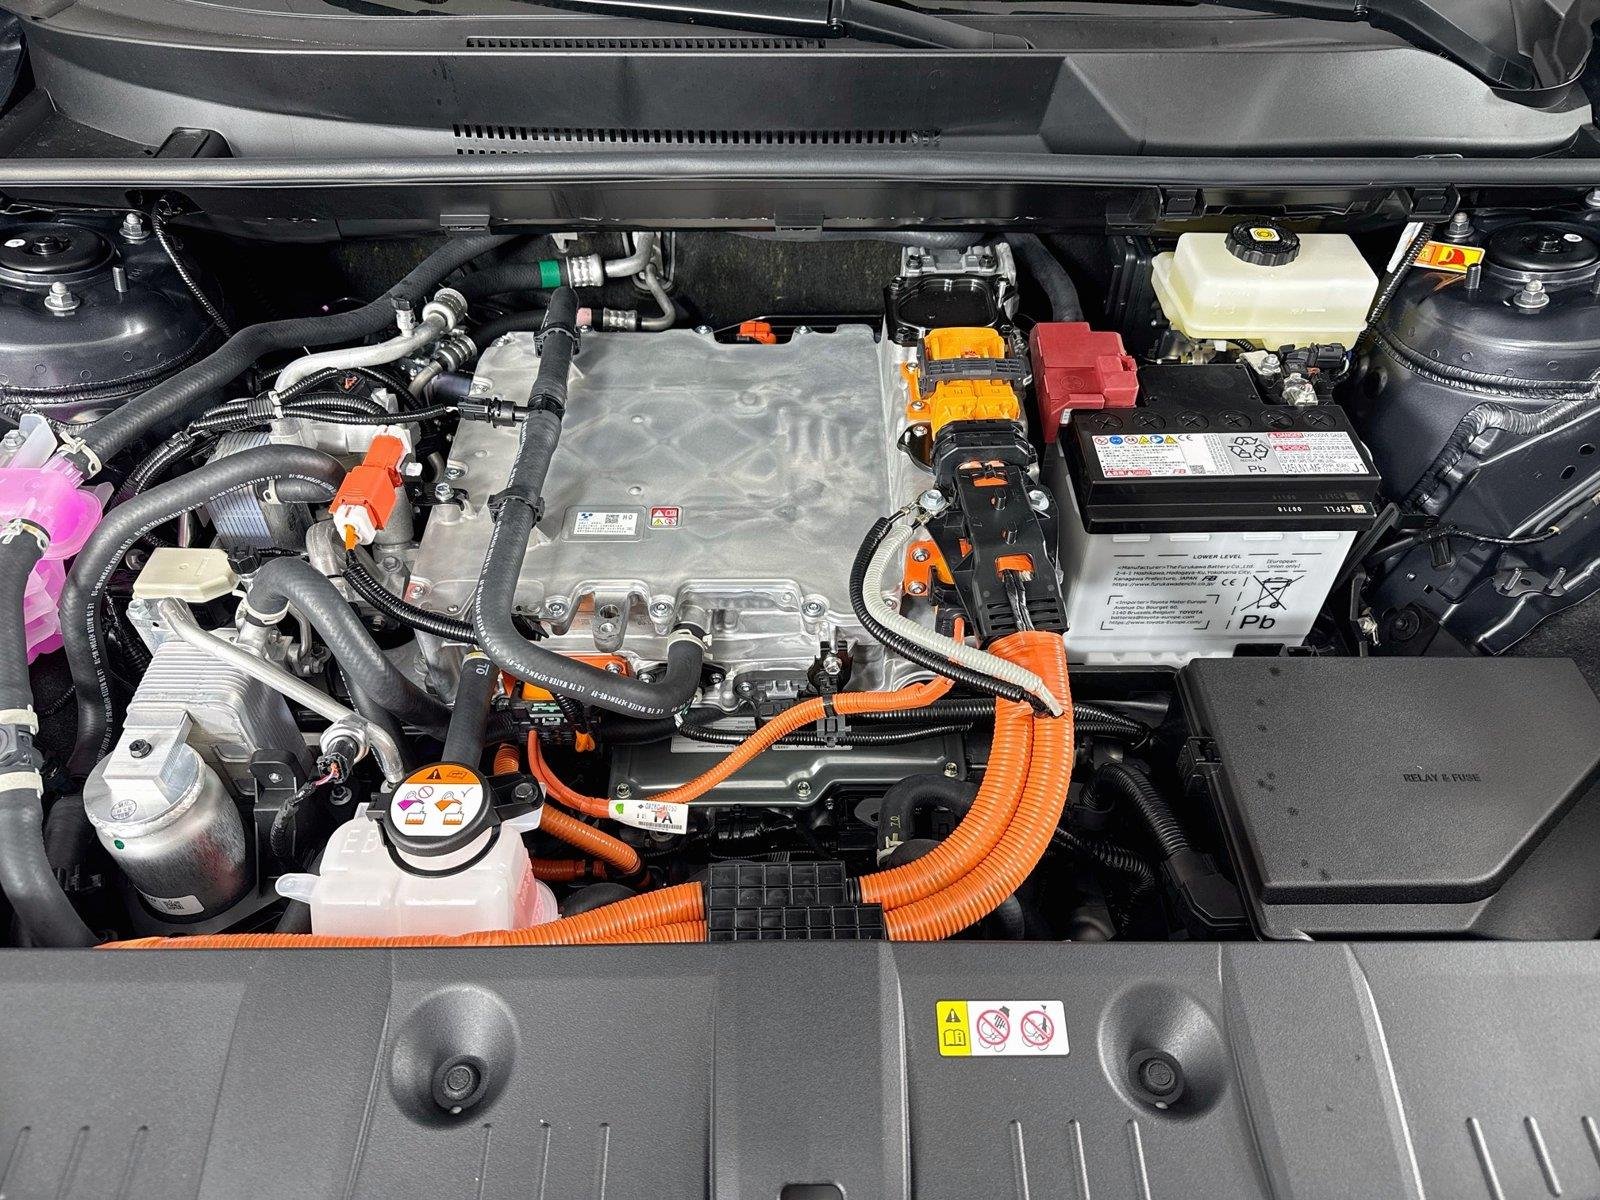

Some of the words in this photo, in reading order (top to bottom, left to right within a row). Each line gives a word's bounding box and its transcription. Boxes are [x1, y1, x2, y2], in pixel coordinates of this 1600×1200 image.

[1239, 614, 1276, 630] Pb
[1403, 774, 1438, 782] RELAY
[1442, 774, 1451, 782] &
[1452, 774, 1482, 782] FUSE
[651, 809, 672, 824] TA
